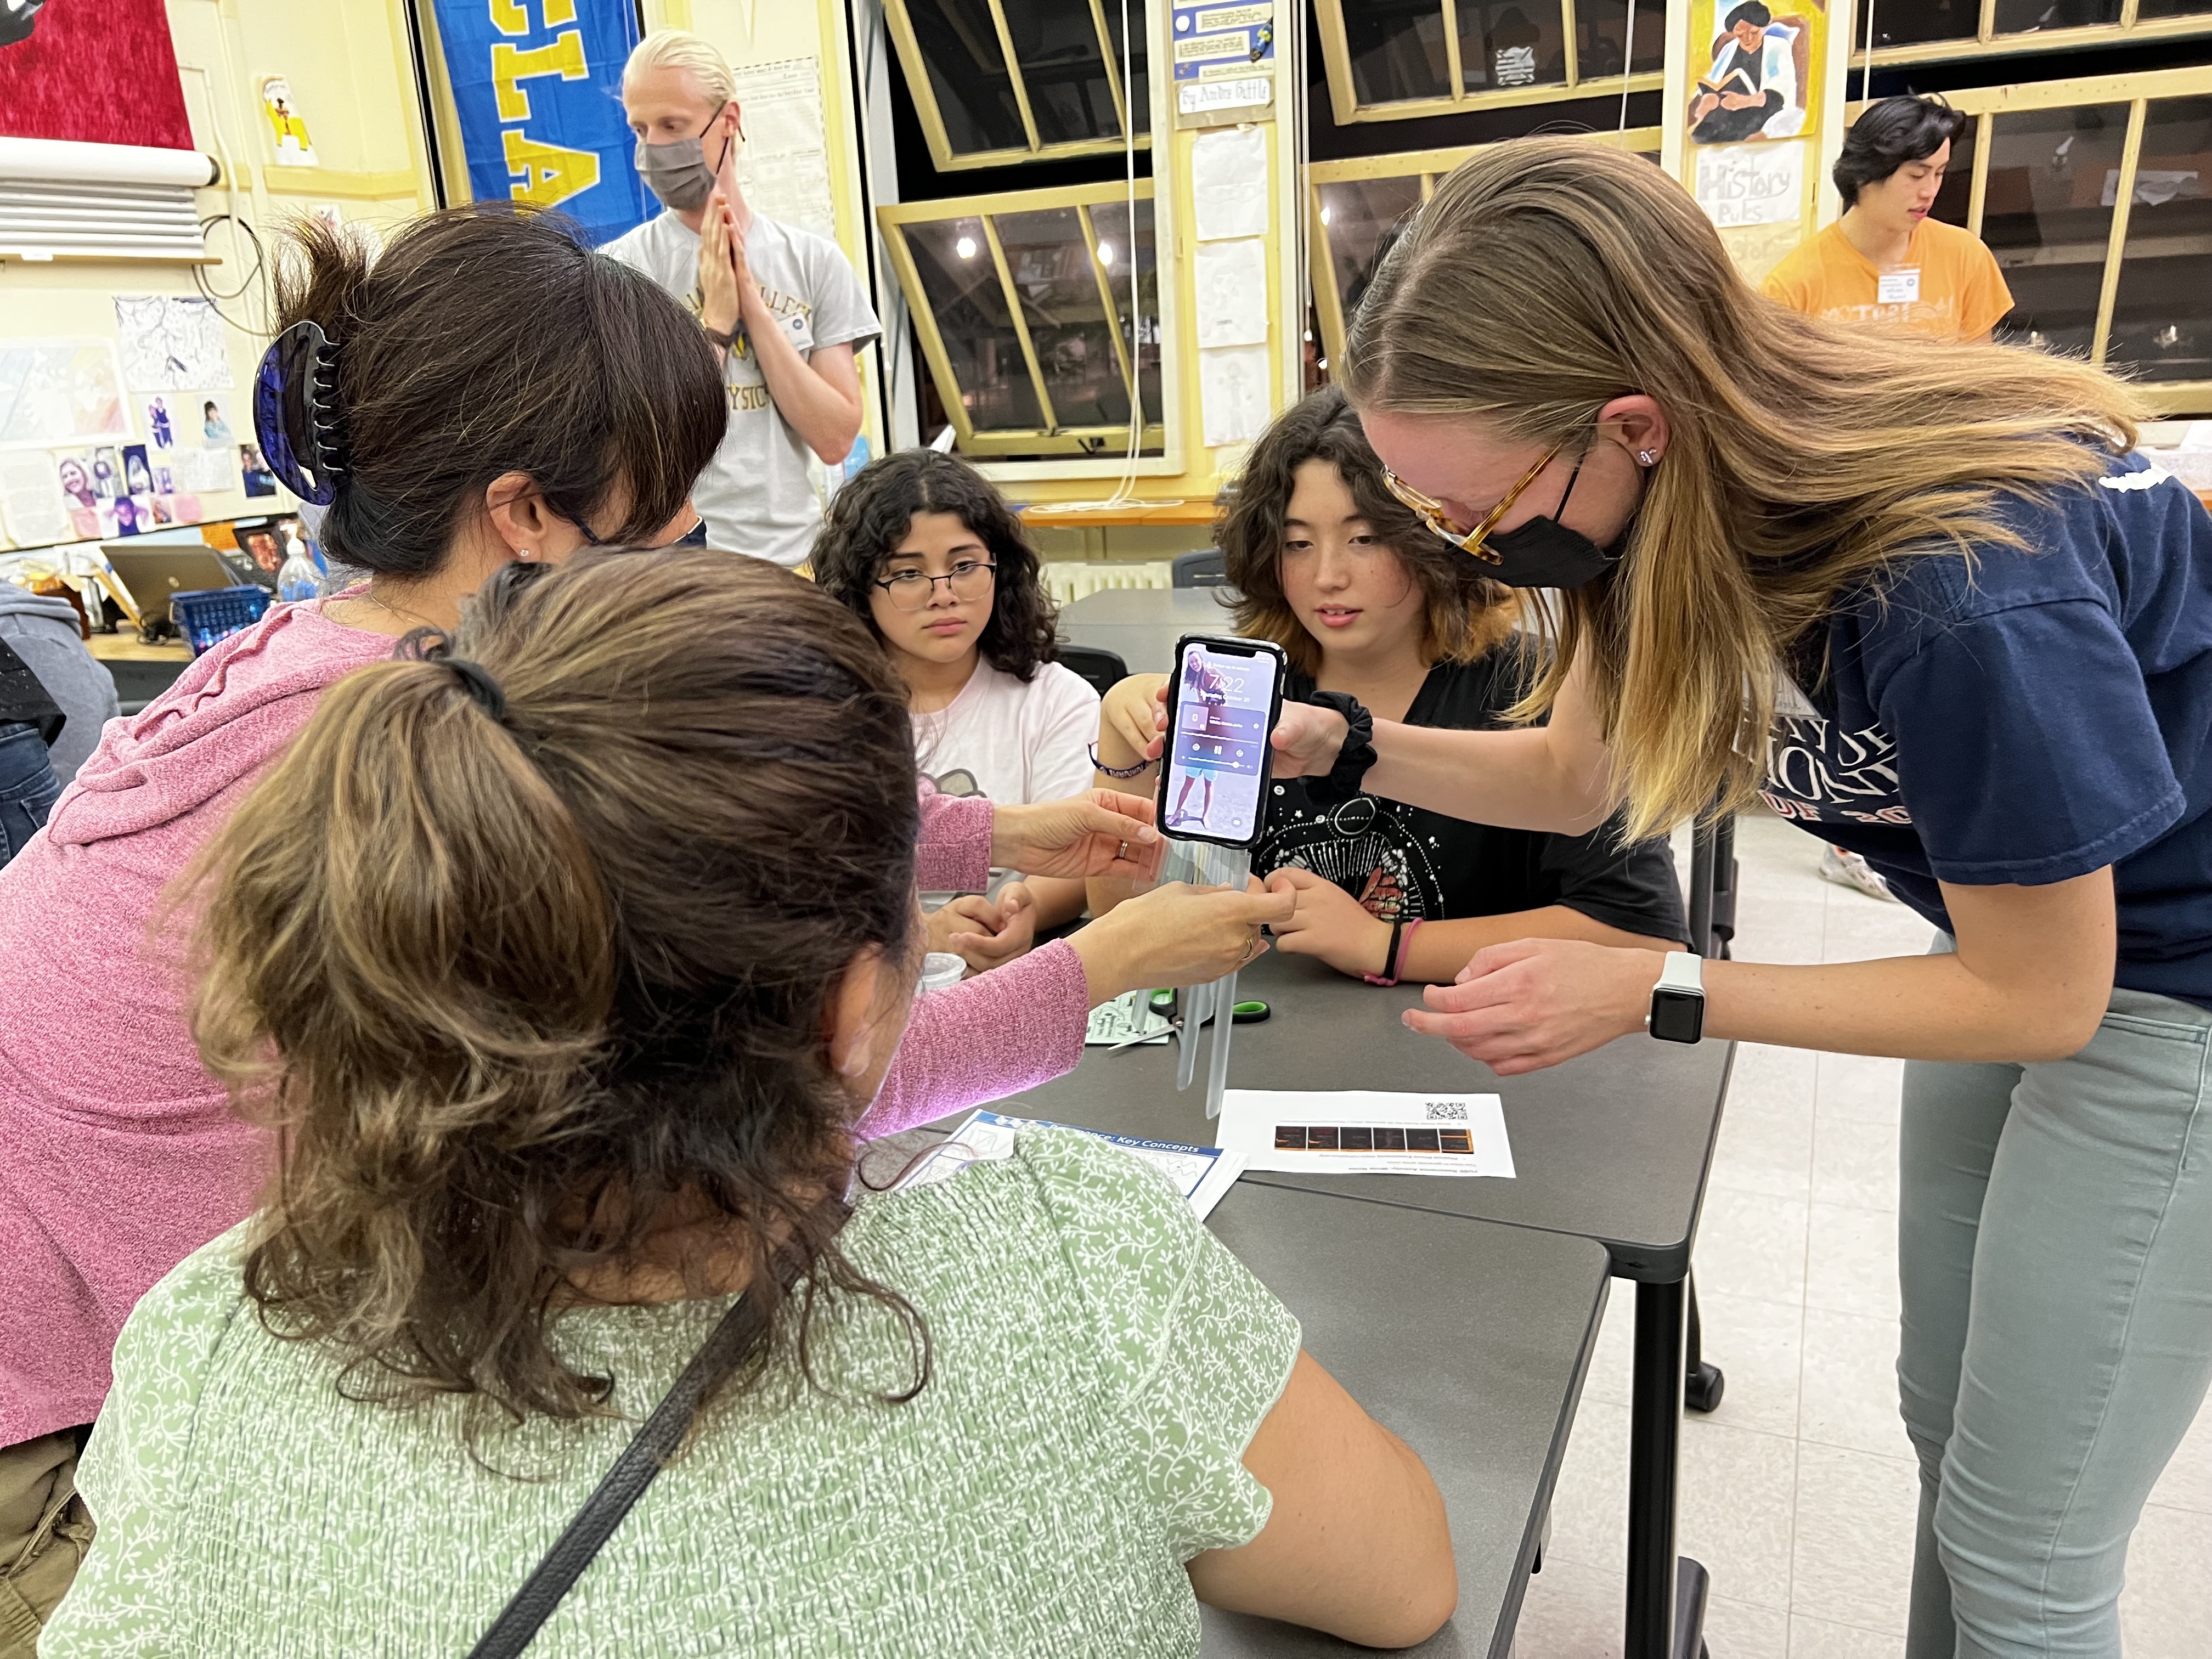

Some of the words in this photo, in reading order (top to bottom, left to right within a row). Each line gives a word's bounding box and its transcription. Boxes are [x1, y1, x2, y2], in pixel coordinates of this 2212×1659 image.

[1209, 673, 1245, 693] 7:22
[1840, 805, 1912, 824] 20
[1116, 1136, 1141, 1146] Key
[1142, 1141, 1200, 1153] Concepts
